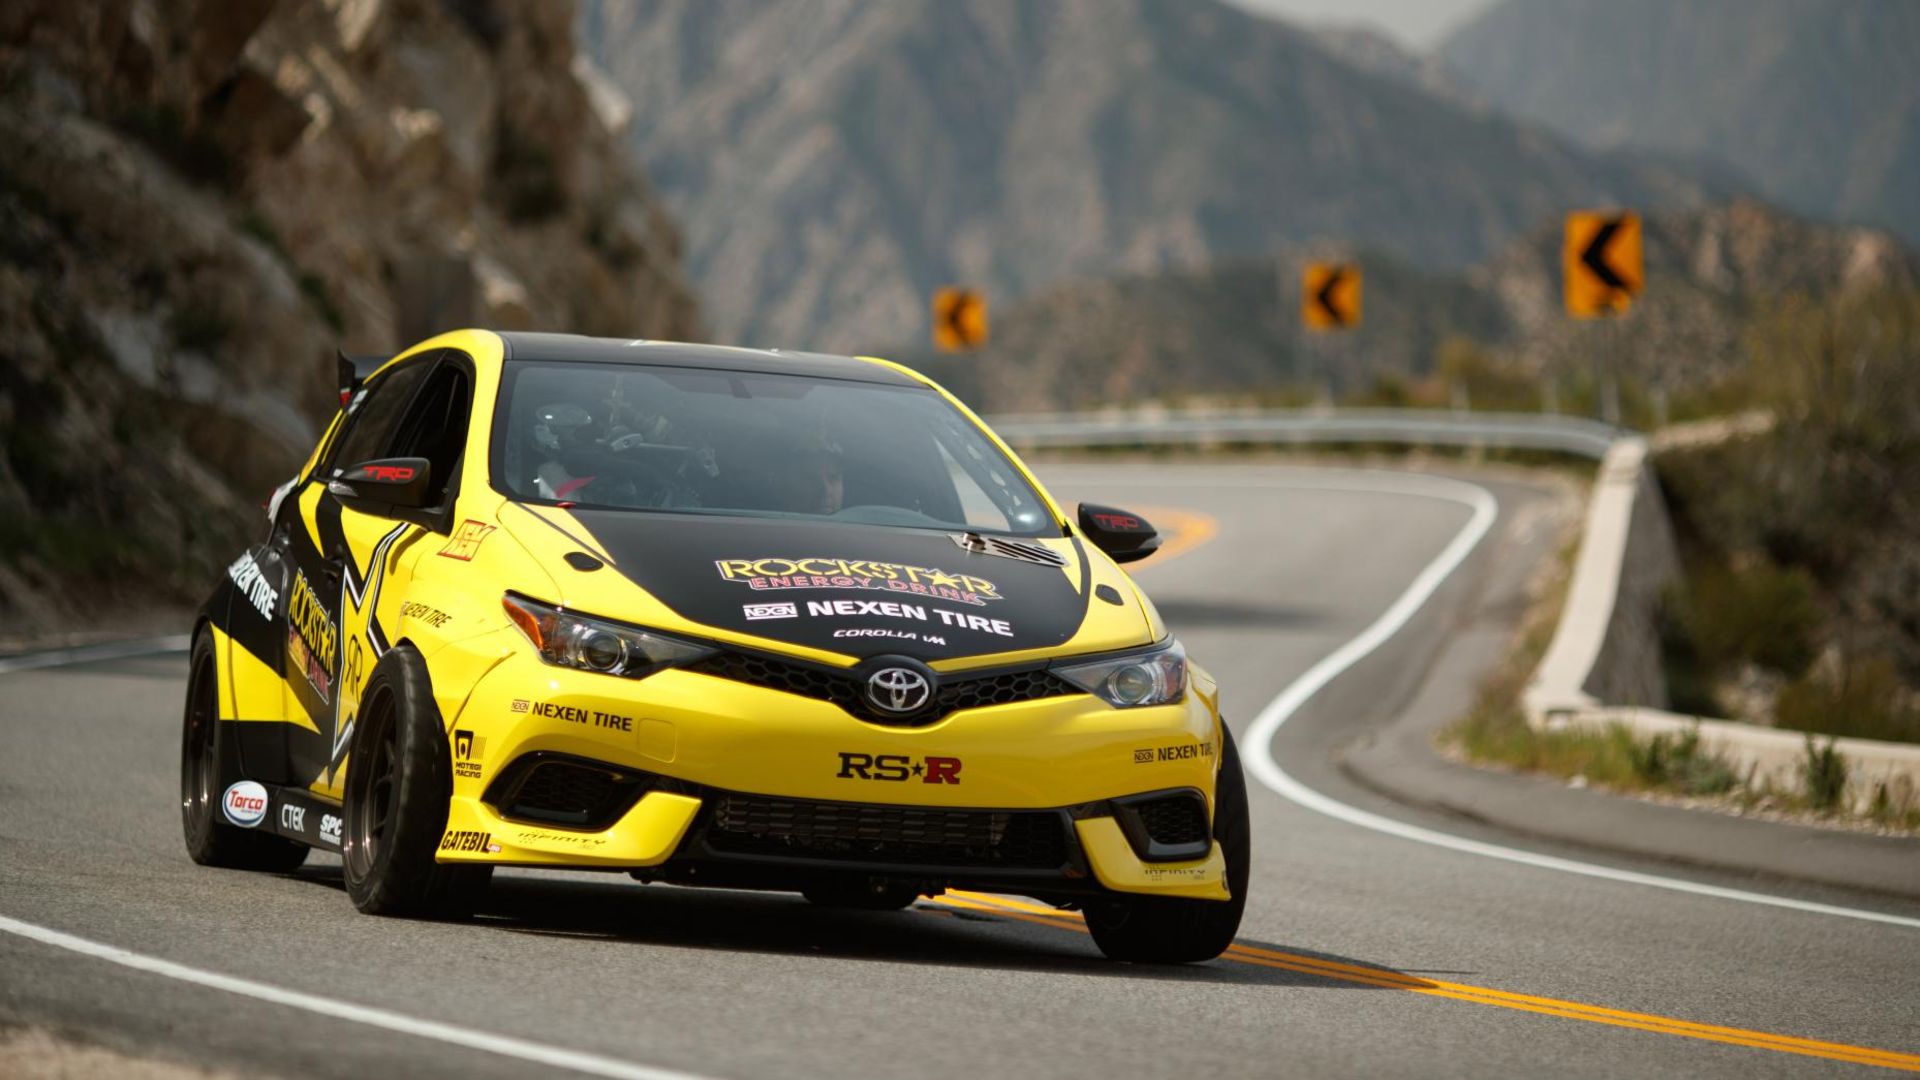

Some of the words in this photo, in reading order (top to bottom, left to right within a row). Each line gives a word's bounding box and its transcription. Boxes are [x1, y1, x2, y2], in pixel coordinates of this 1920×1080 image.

[363, 466, 414, 481] TRD
[1093, 513, 1140, 529] TRD
[249, 573, 279, 622] TIRE
[751, 576, 872, 589] ENERGY
[886, 579, 979, 602] DRINK
[806, 600, 928, 621] NEXEN
[932, 608, 1015, 637] TIRE
[833, 629, 917, 640] COROLLA
[532, 702, 588, 724] NEXEN
[593, 711, 633, 732] TIRE
[1158, 744, 1197, 761] NEXEN
[455, 762, 482, 771] MOTEGI
[455, 769, 482, 779] RACING
[230, 790, 264, 811] Torco
[281, 803, 305, 833] CTEK
[320, 814, 342, 837] SPC
[441, 831, 491, 854] GATEBIL
